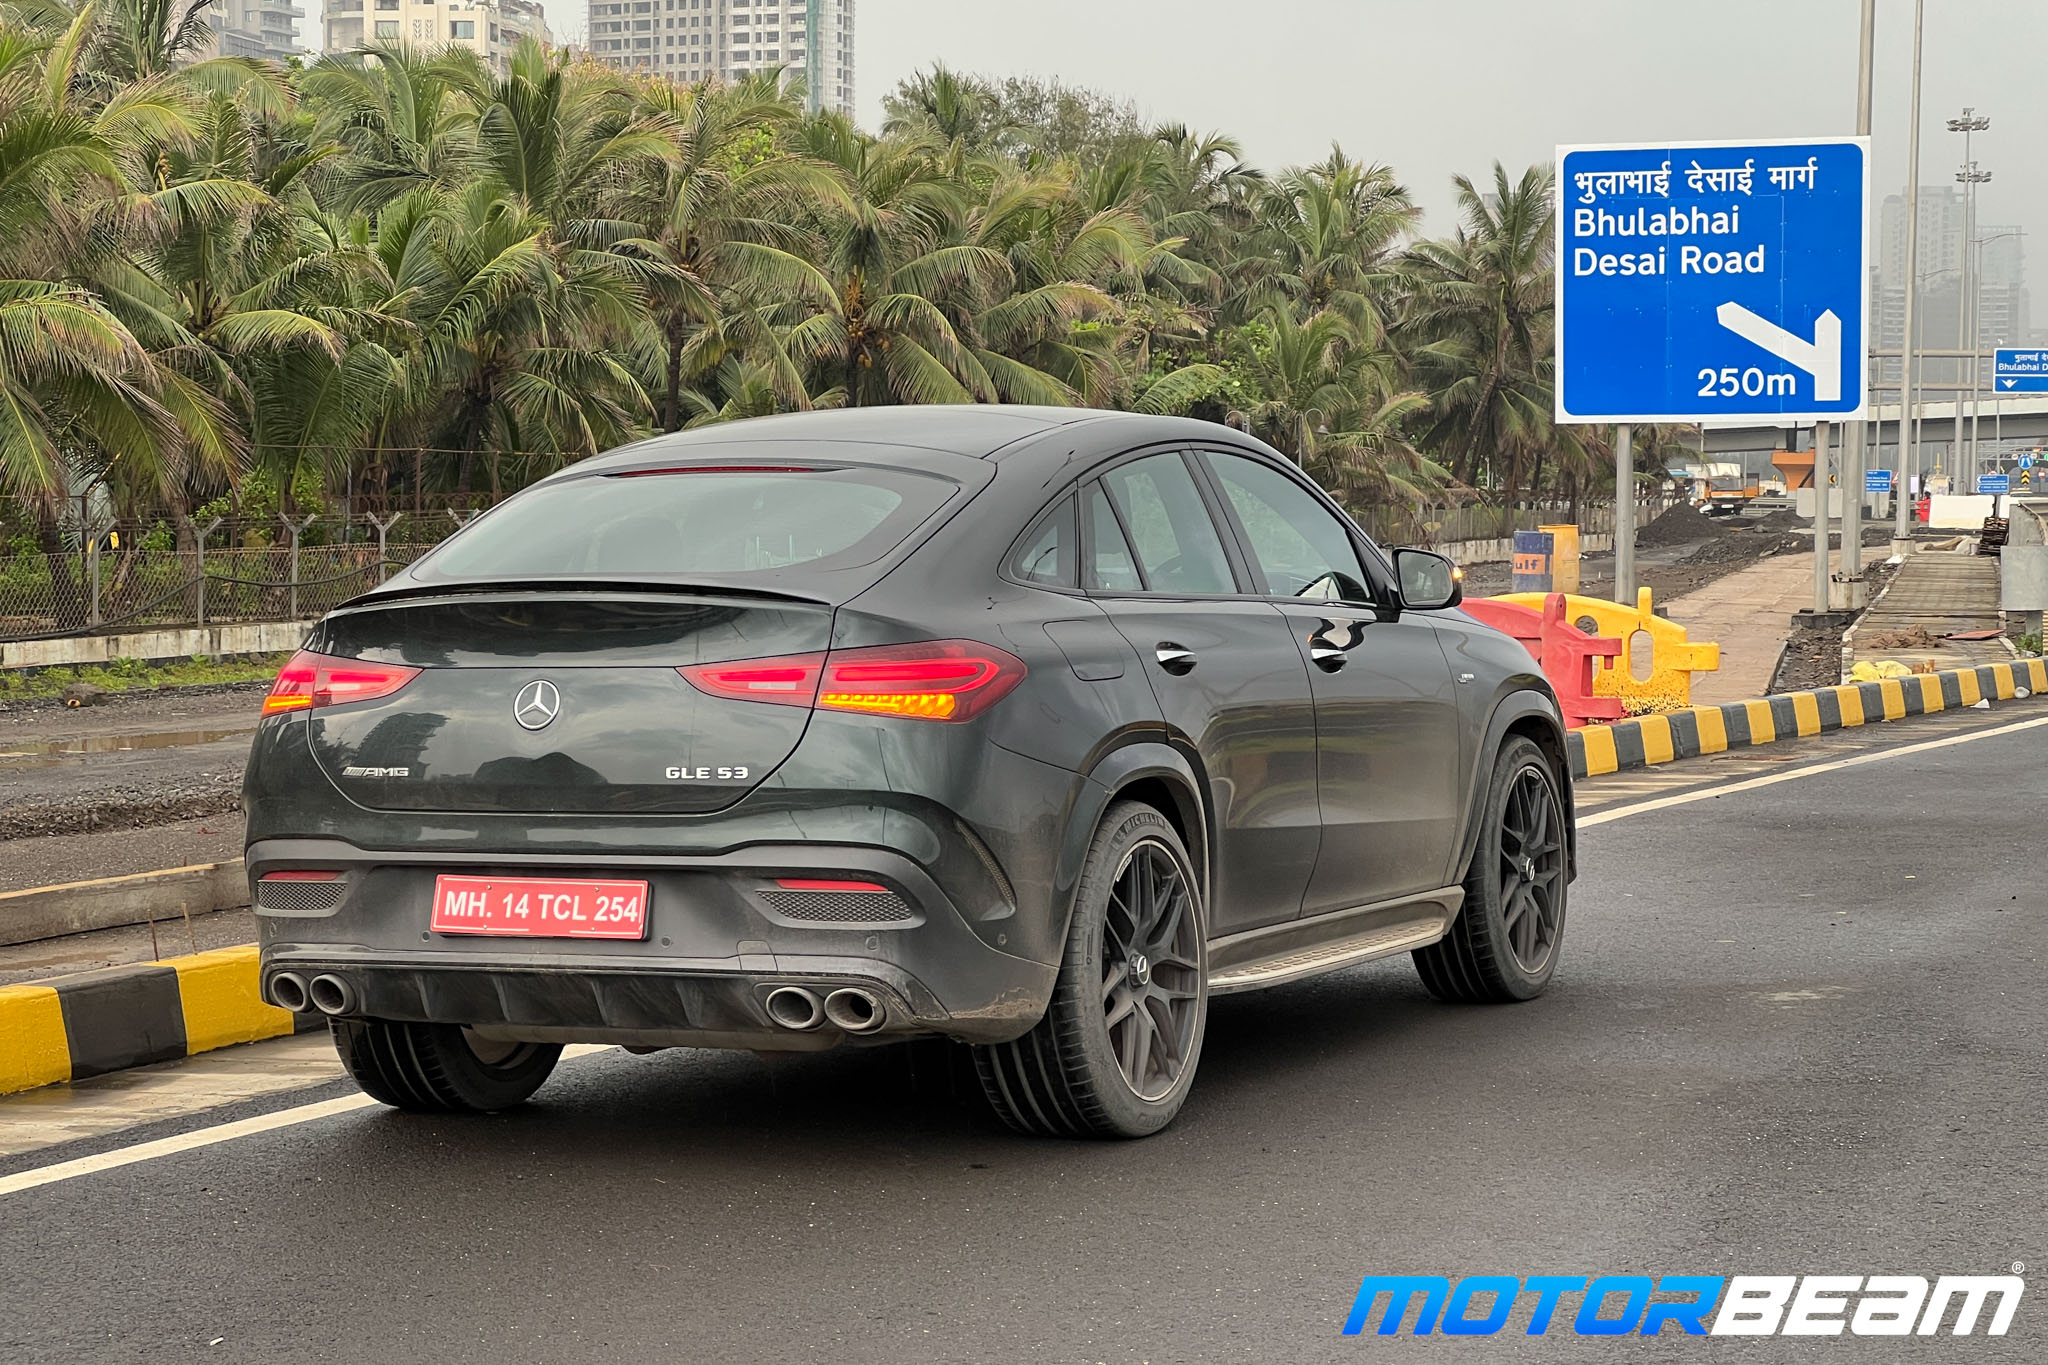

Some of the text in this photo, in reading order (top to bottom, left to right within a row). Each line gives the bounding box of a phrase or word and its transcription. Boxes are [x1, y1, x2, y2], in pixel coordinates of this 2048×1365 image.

[1574, 157, 1818, 204] भुलाभाई देसाई मार्ग
[1574, 205, 1739, 237] Bhulabhai
[1574, 244, 1765, 276] Desai Road
[1998, 362, 2040, 371] Bhulabhai
[1697, 367, 1797, 398] 250m
[1513, 559, 1538, 570] ulf
[361, 767, 409, 777] AMG
[665, 766, 749, 779] GLE 53
[444, 890, 639, 922] MH. 14 TCL 254
